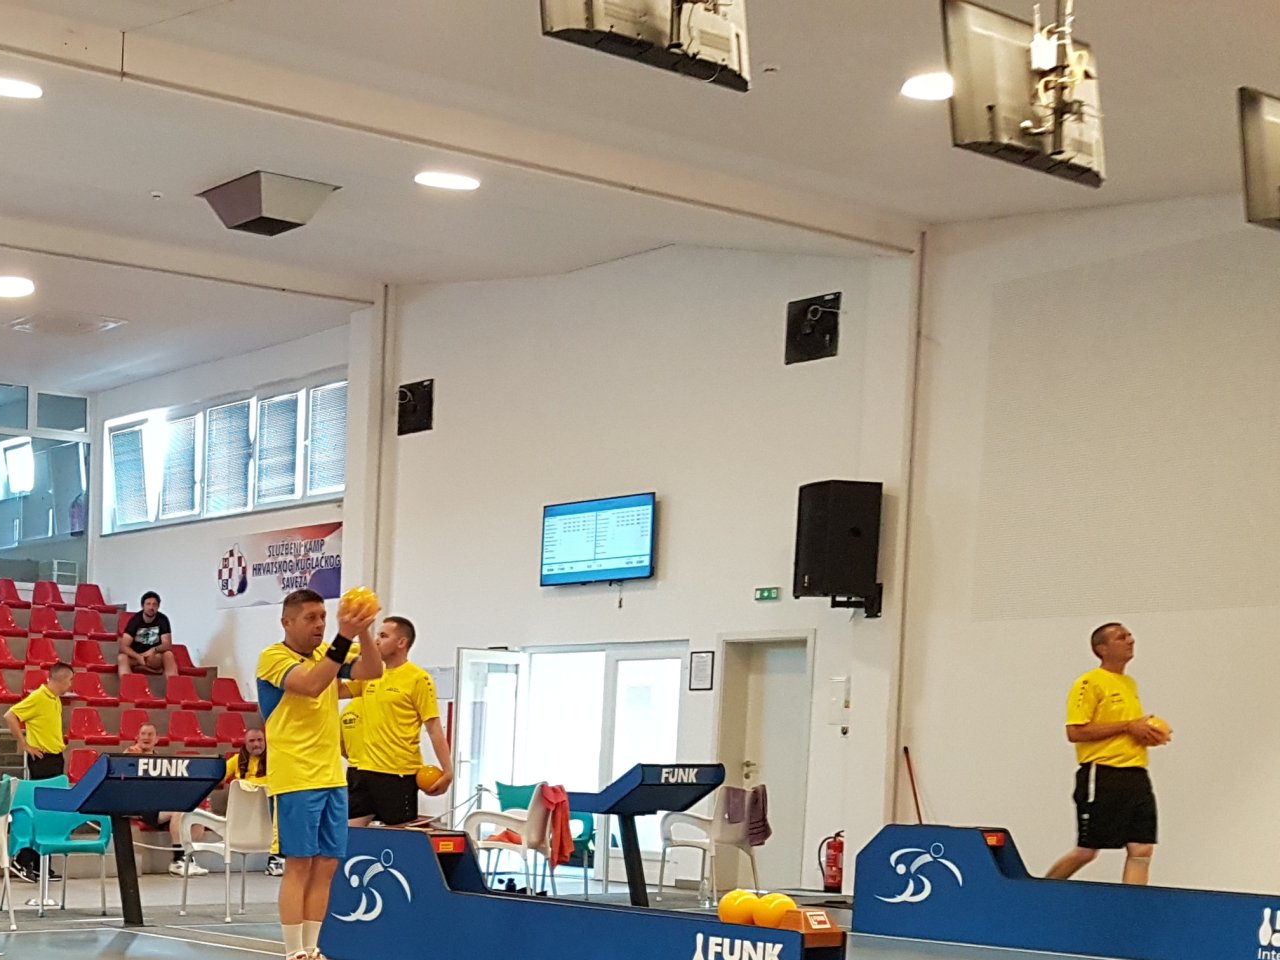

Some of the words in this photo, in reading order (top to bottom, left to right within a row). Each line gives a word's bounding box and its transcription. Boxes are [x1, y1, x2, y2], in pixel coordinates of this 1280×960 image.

[267, 541, 302, 558] SLUŽBENI
[303, 539, 325, 555] KAMP
[252, 558, 294, 577] HRVATSKOG
[281, 576, 308, 590] SAVEZA
[137, 758, 191, 777] FUNK
[660, 768, 698, 783] FUNK
